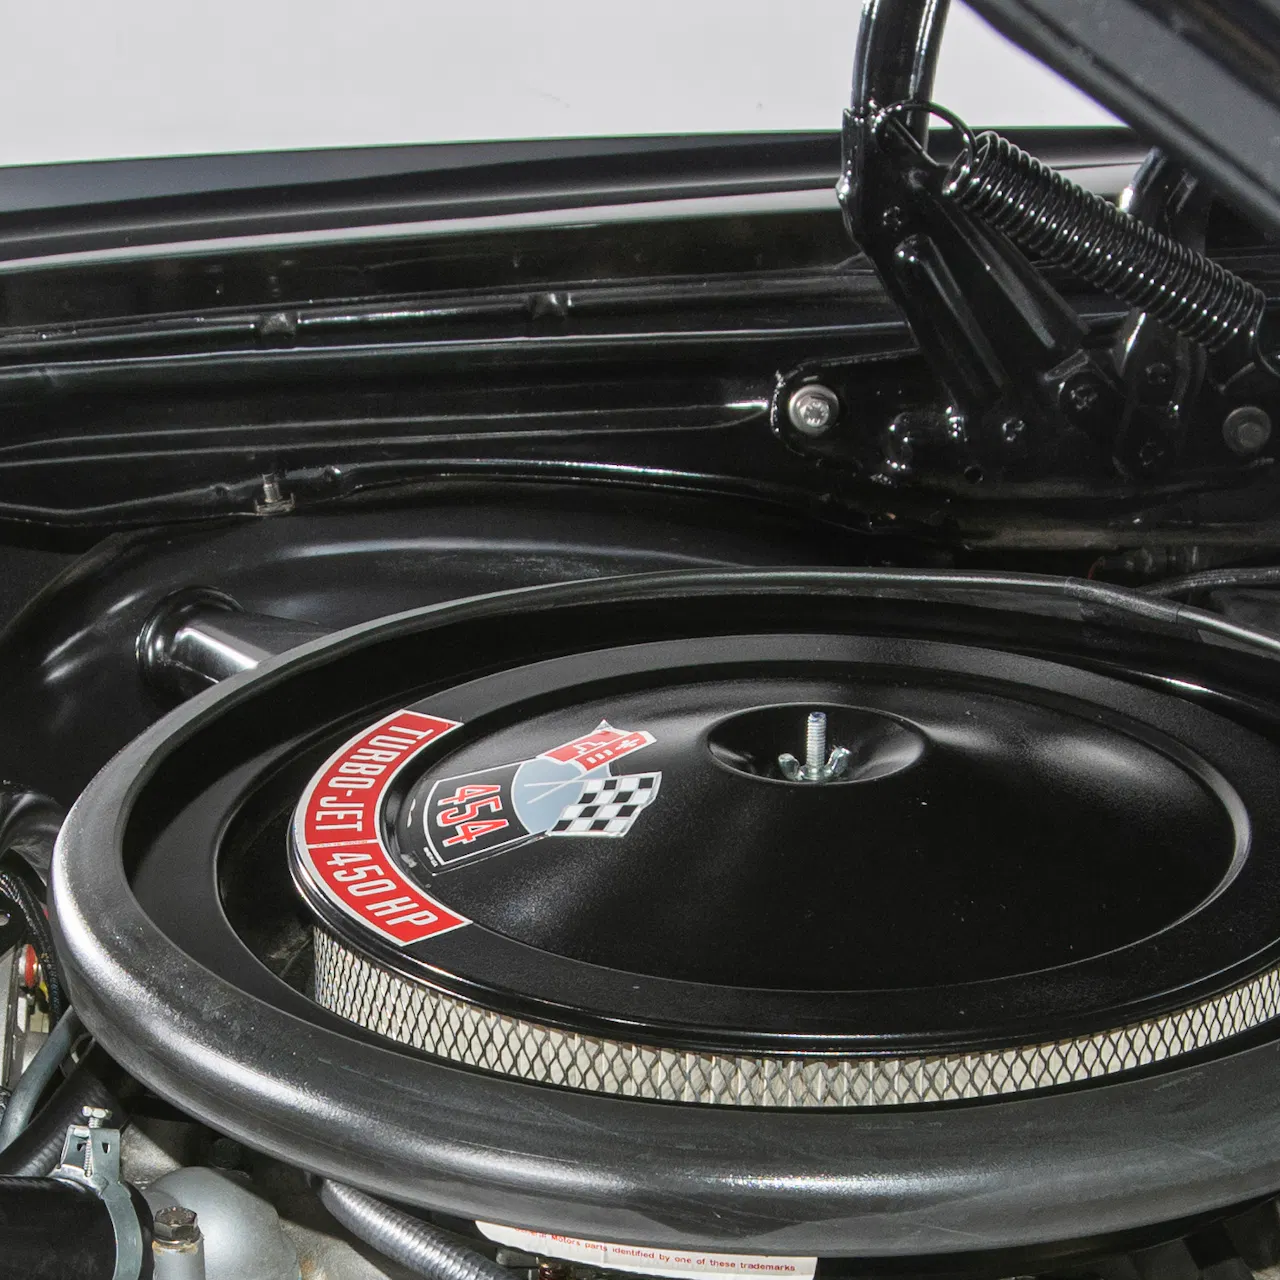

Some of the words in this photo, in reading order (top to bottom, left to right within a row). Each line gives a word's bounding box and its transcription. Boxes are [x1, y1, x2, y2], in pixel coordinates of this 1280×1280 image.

[315, 724, 435, 833] TURBO-JET
[436, 783, 510, 848] 454
[326, 852, 398, 898] 450
[365, 896, 439, 927] HP
[551, 1233, 581, 1247] Motors
[584, 1241, 608, 1252] parts
[612, 1246, 655, 1260] identified
[658, 1253, 670, 1263] by
[674, 1256, 692, 1264] one
[696, 1258, 706, 1266] of
[709, 1259, 736, 1268] these
[739, 1261, 796, 1272] trademarks
